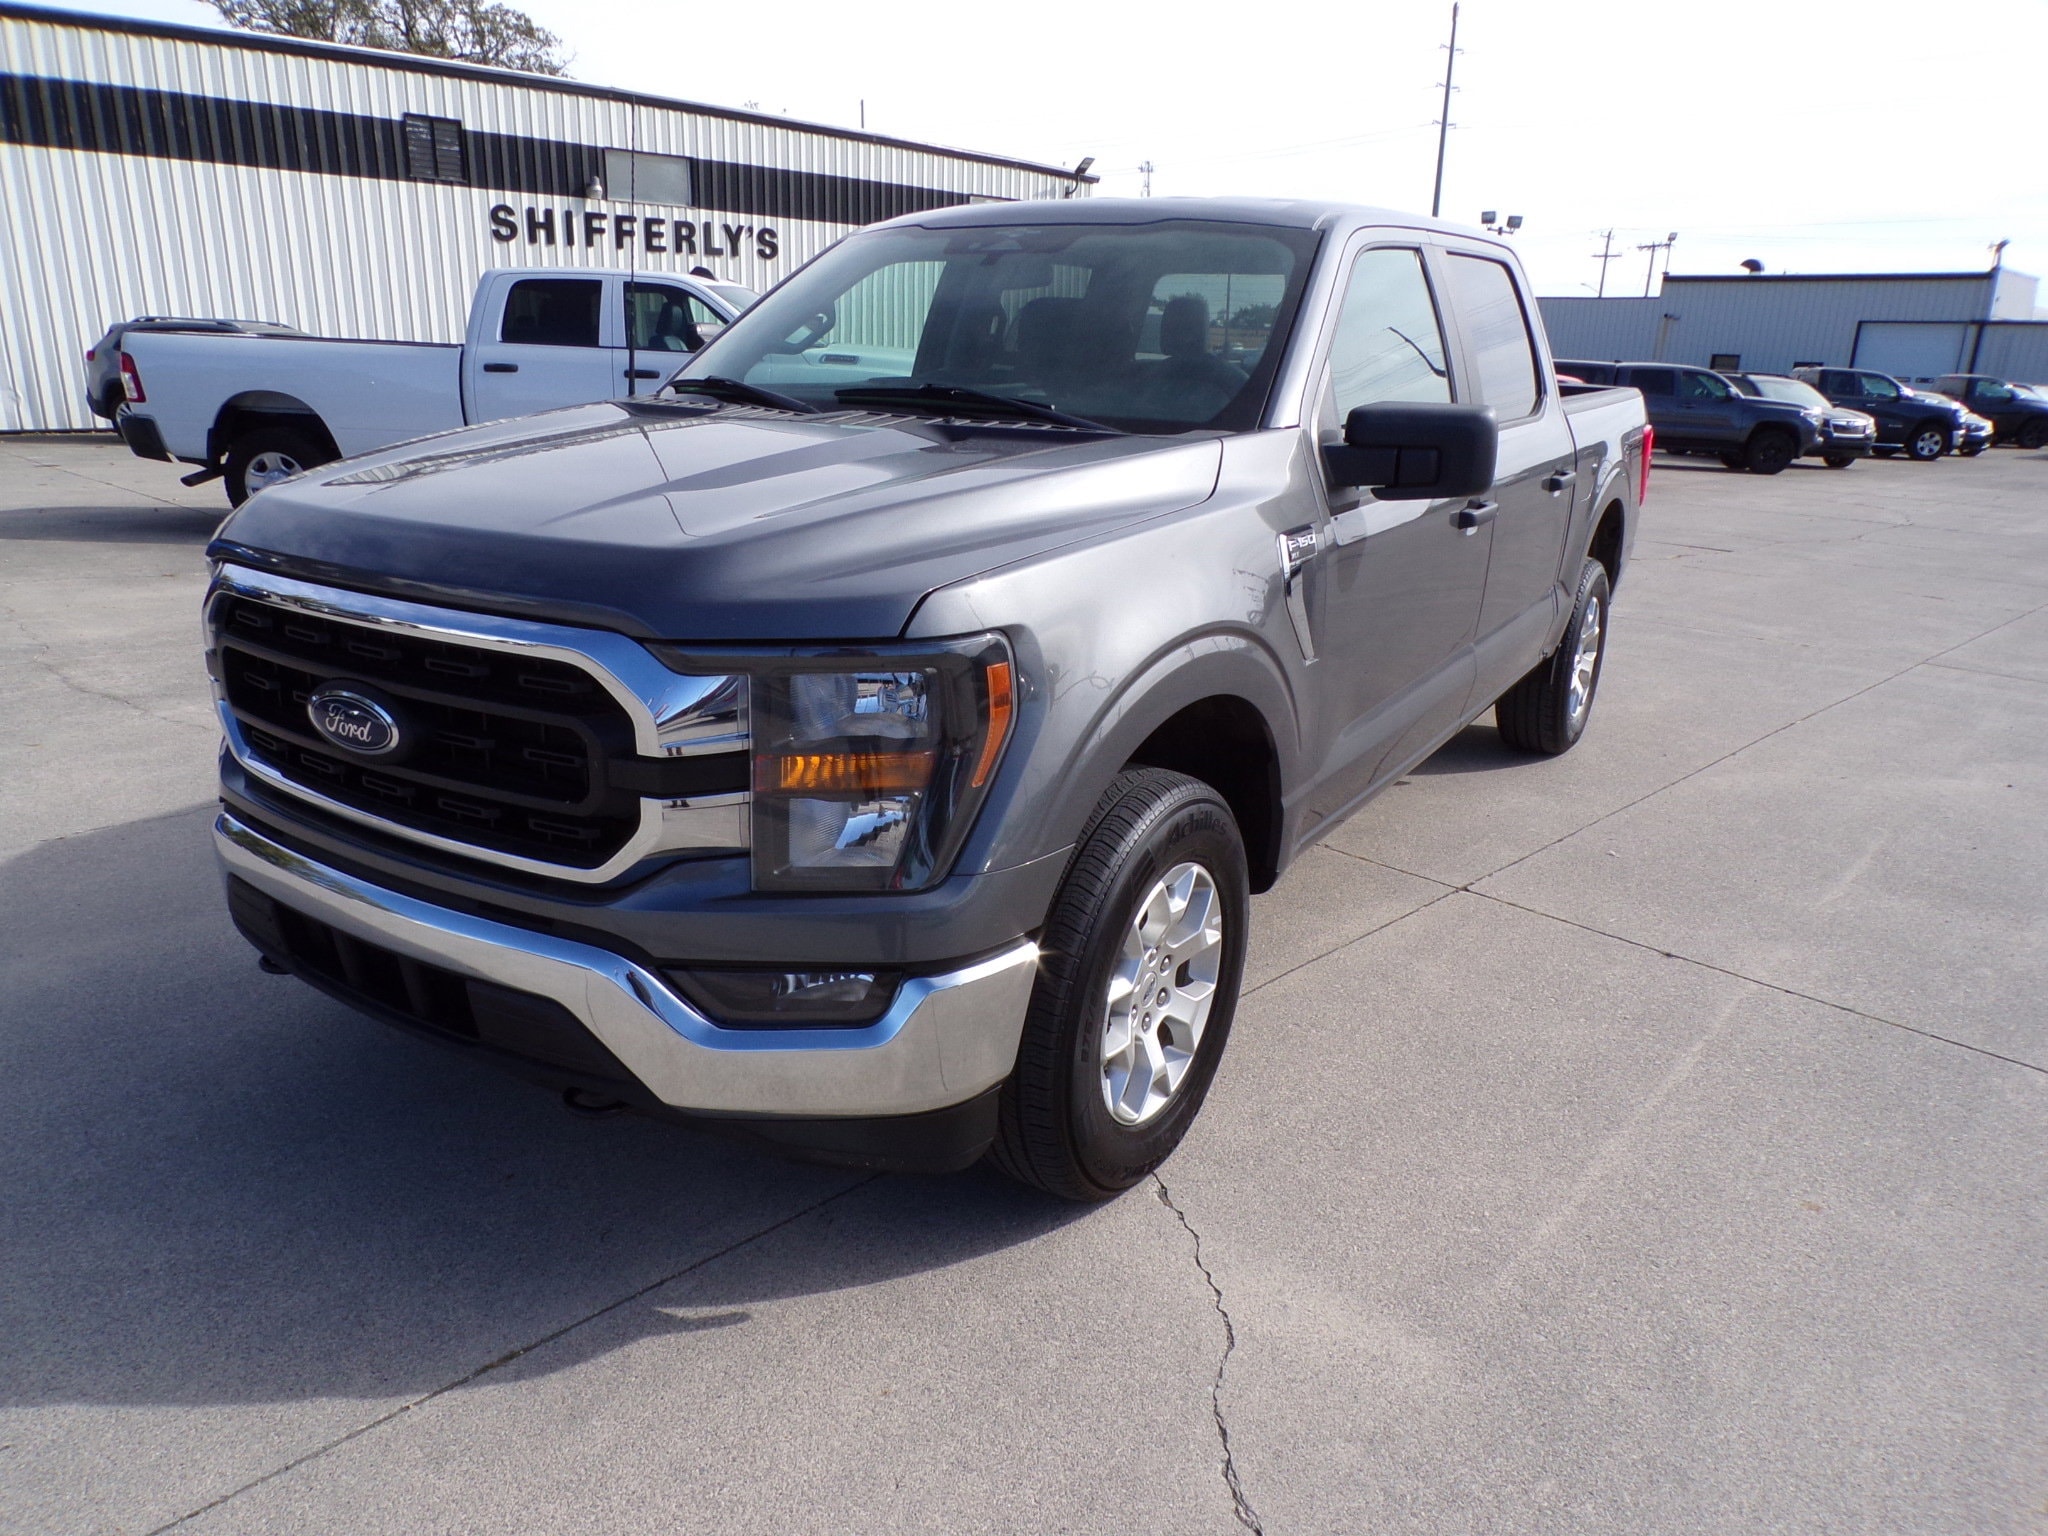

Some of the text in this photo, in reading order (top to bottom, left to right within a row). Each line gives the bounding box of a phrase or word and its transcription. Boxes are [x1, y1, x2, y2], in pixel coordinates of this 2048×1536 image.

[490, 204, 779, 260] SHIFFERLY'S
[1288, 534, 1316, 551] F-150
[325, 703, 372, 742] Ford
